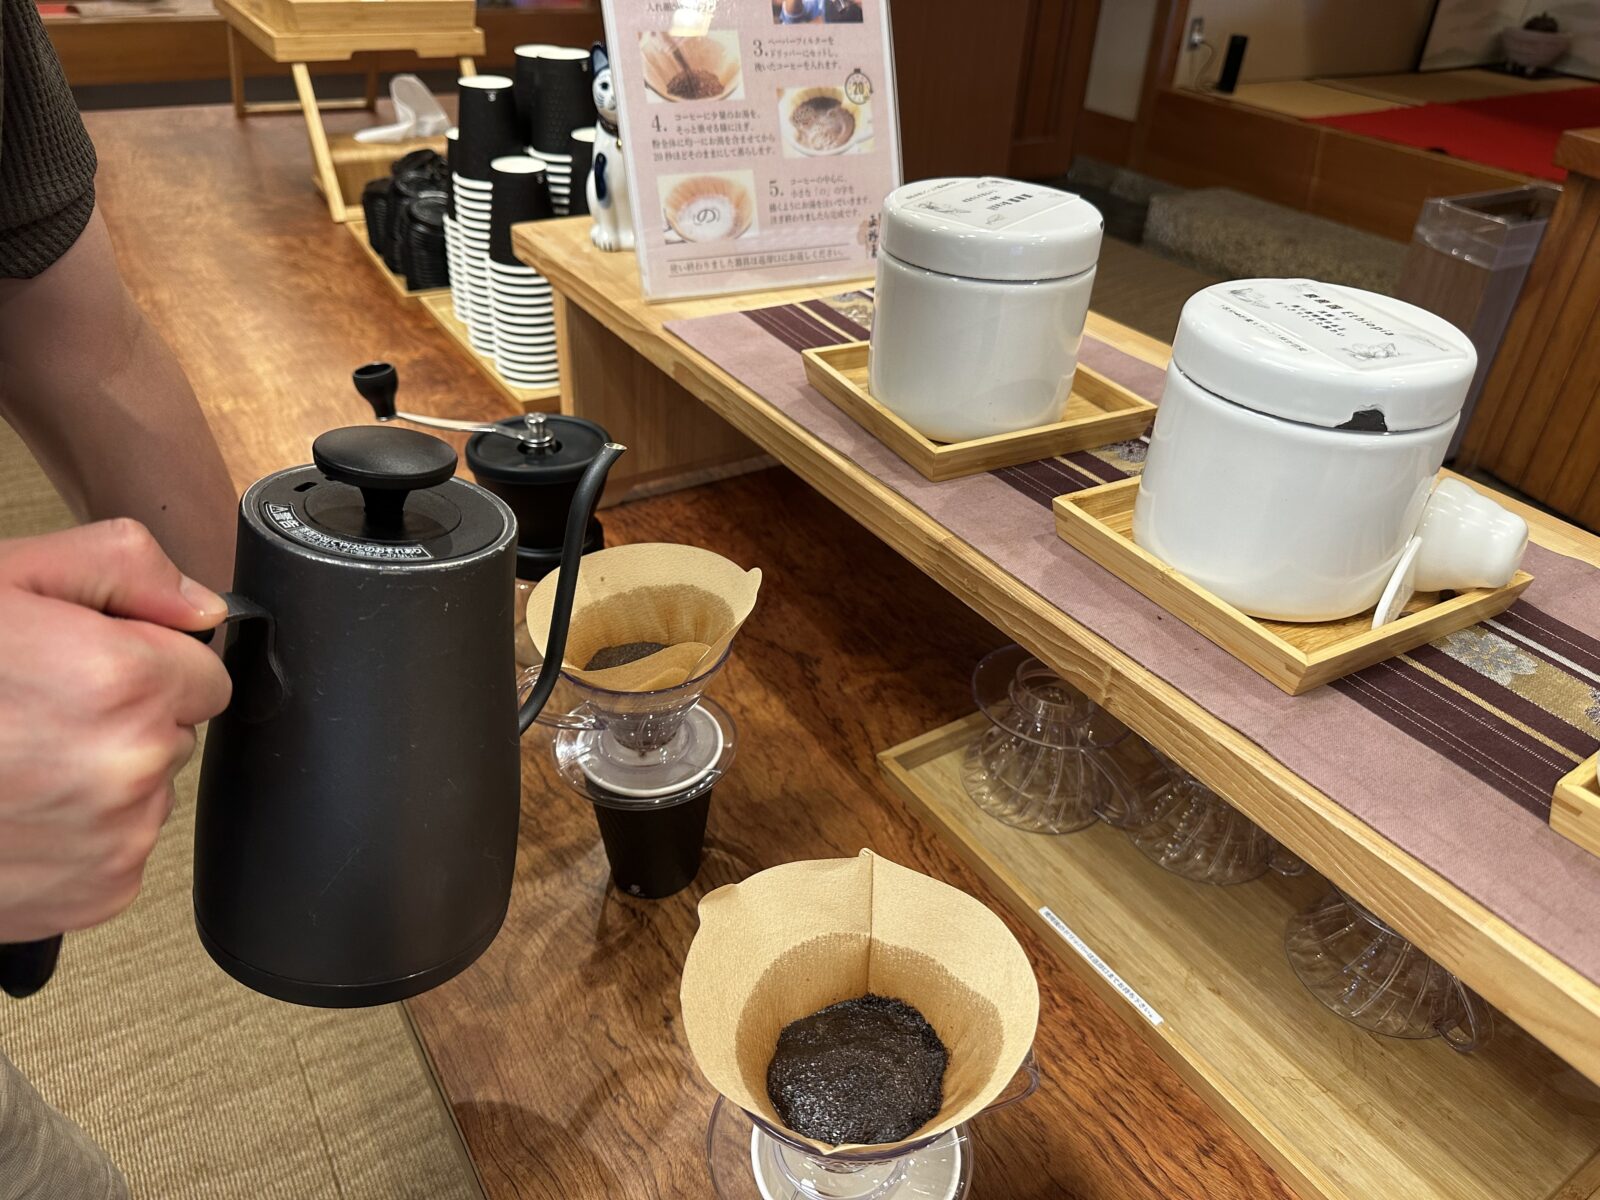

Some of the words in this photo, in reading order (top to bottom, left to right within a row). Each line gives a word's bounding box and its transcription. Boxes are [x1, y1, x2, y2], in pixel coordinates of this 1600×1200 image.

[753, 39, 768, 57] 3.
[651, 114, 668, 132] 4.
[768, 180, 784, 197] 5.
[1341, 311, 1394, 336] Ethiopia
